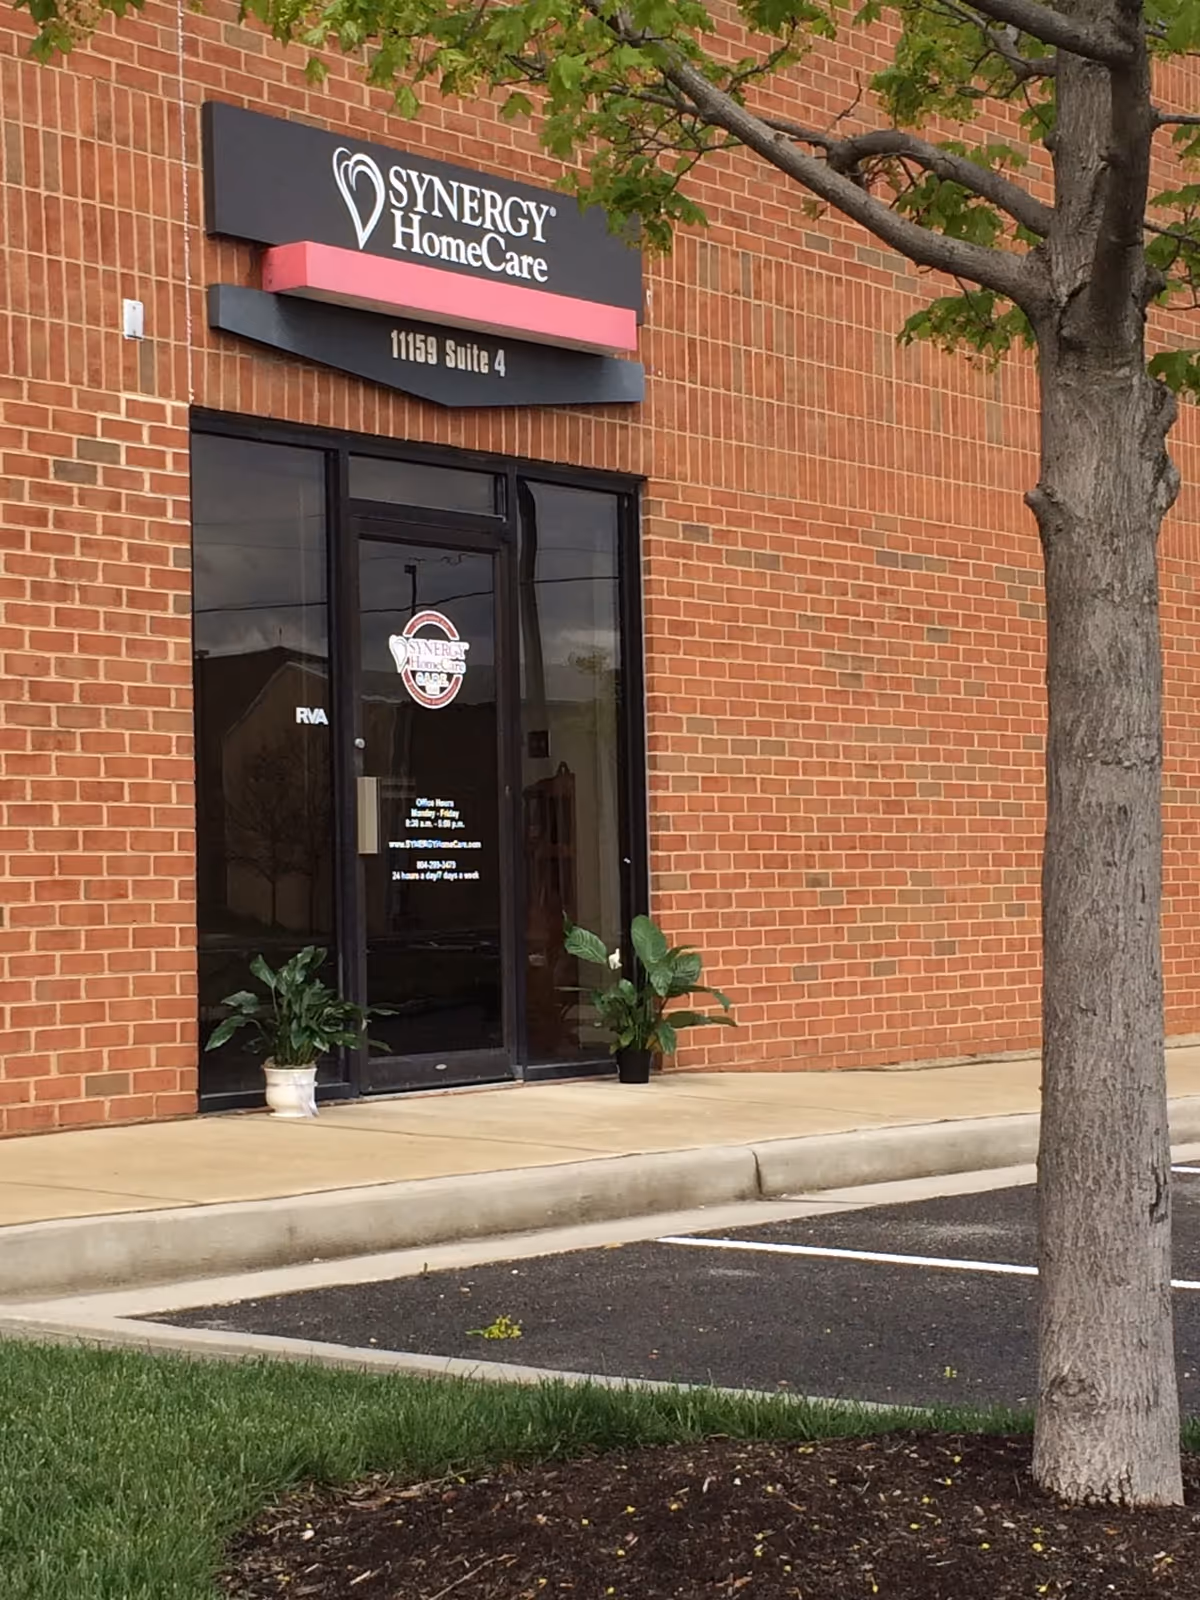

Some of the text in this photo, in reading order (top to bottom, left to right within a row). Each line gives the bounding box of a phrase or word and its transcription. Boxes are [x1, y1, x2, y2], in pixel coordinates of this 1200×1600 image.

[392, 209, 549, 283] HomeCare
[390, 329, 507, 378] 11159 Suite 4
[409, 639, 465, 658] SYNERGY
[410, 655, 465, 672] HomeCare
[296, 707, 328, 725] RVA
[416, 798, 454, 808] Office Hours
[411, 808, 435, 819] Monday
[440, 809, 460, 820] Friday
[392, 871, 401, 880] 24
[401, 871, 419, 880] hours
[443, 871, 457, 881] days
[463, 871, 480, 880] week
